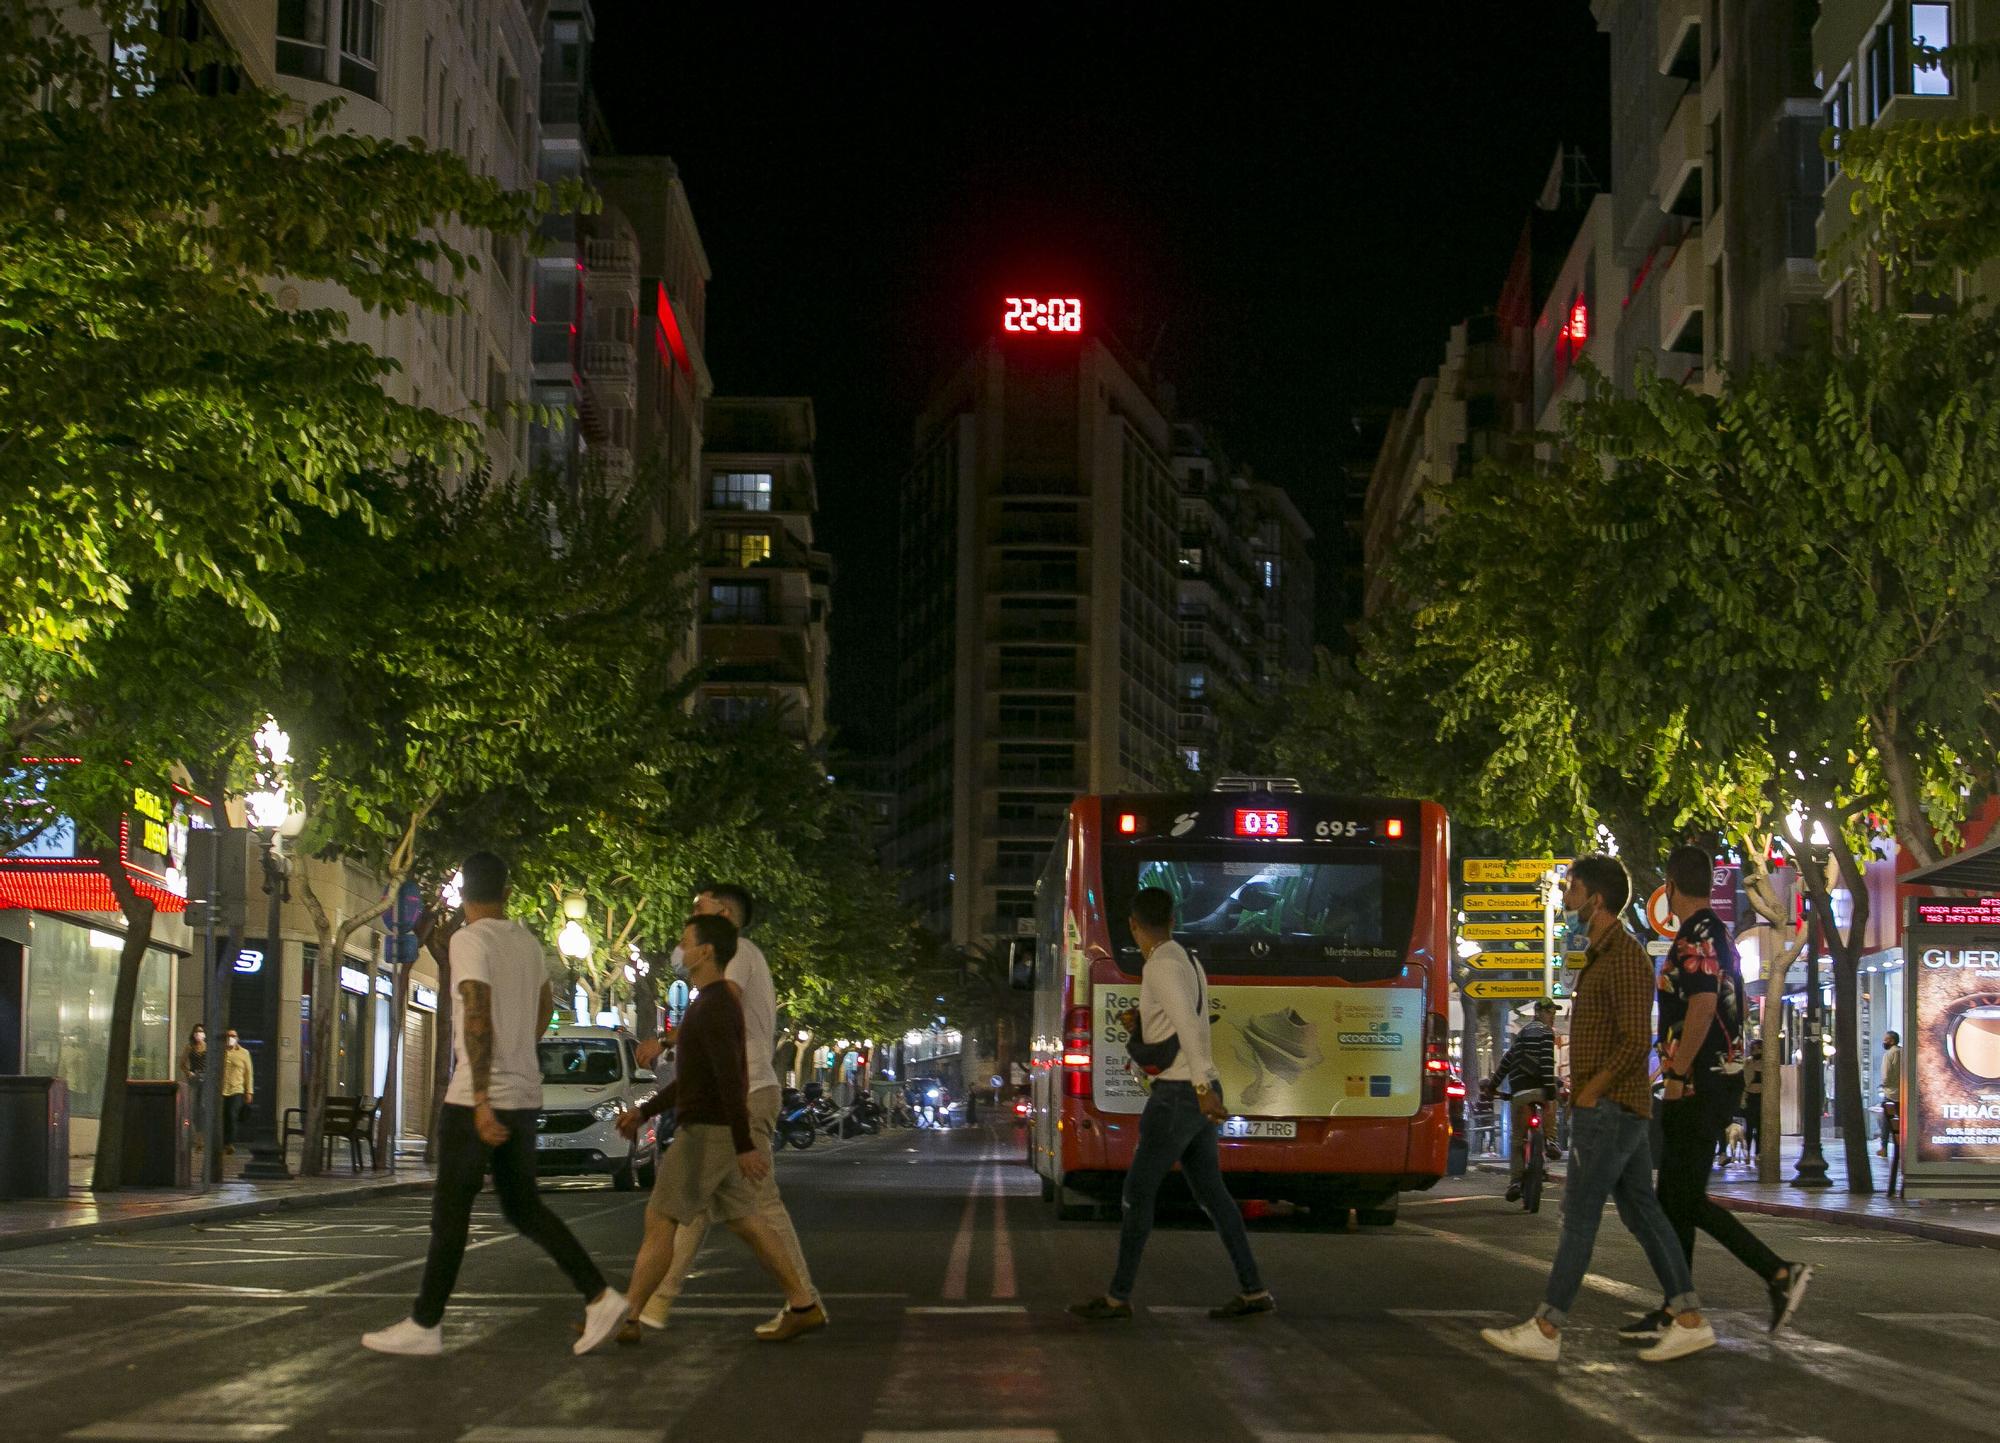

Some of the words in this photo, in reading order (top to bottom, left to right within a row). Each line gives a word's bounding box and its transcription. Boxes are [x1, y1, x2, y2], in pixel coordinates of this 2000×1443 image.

[1245, 813, 1279, 833] 05
[1315, 820, 1358, 837] 695
[1467, 899, 1484, 907] San
[1920, 906, 1950, 914] PARADA
[1952, 907, 1991, 915] AFECTADA
[1945, 915, 1966, 923] INFO
[1466, 927, 1501, 936] Alfonso
[1923, 949, 2000, 969] GUER
[1339, 1034, 1401, 1043] ecoembes
[1105, 1056, 1120, 1065] En
[1105, 1076, 1120, 1086] els
[1226, 1121, 1262, 1136] 5147
[1265, 1122, 1293, 1136] HRG
[1932, 1136, 1976, 1144] DERIVADOS
